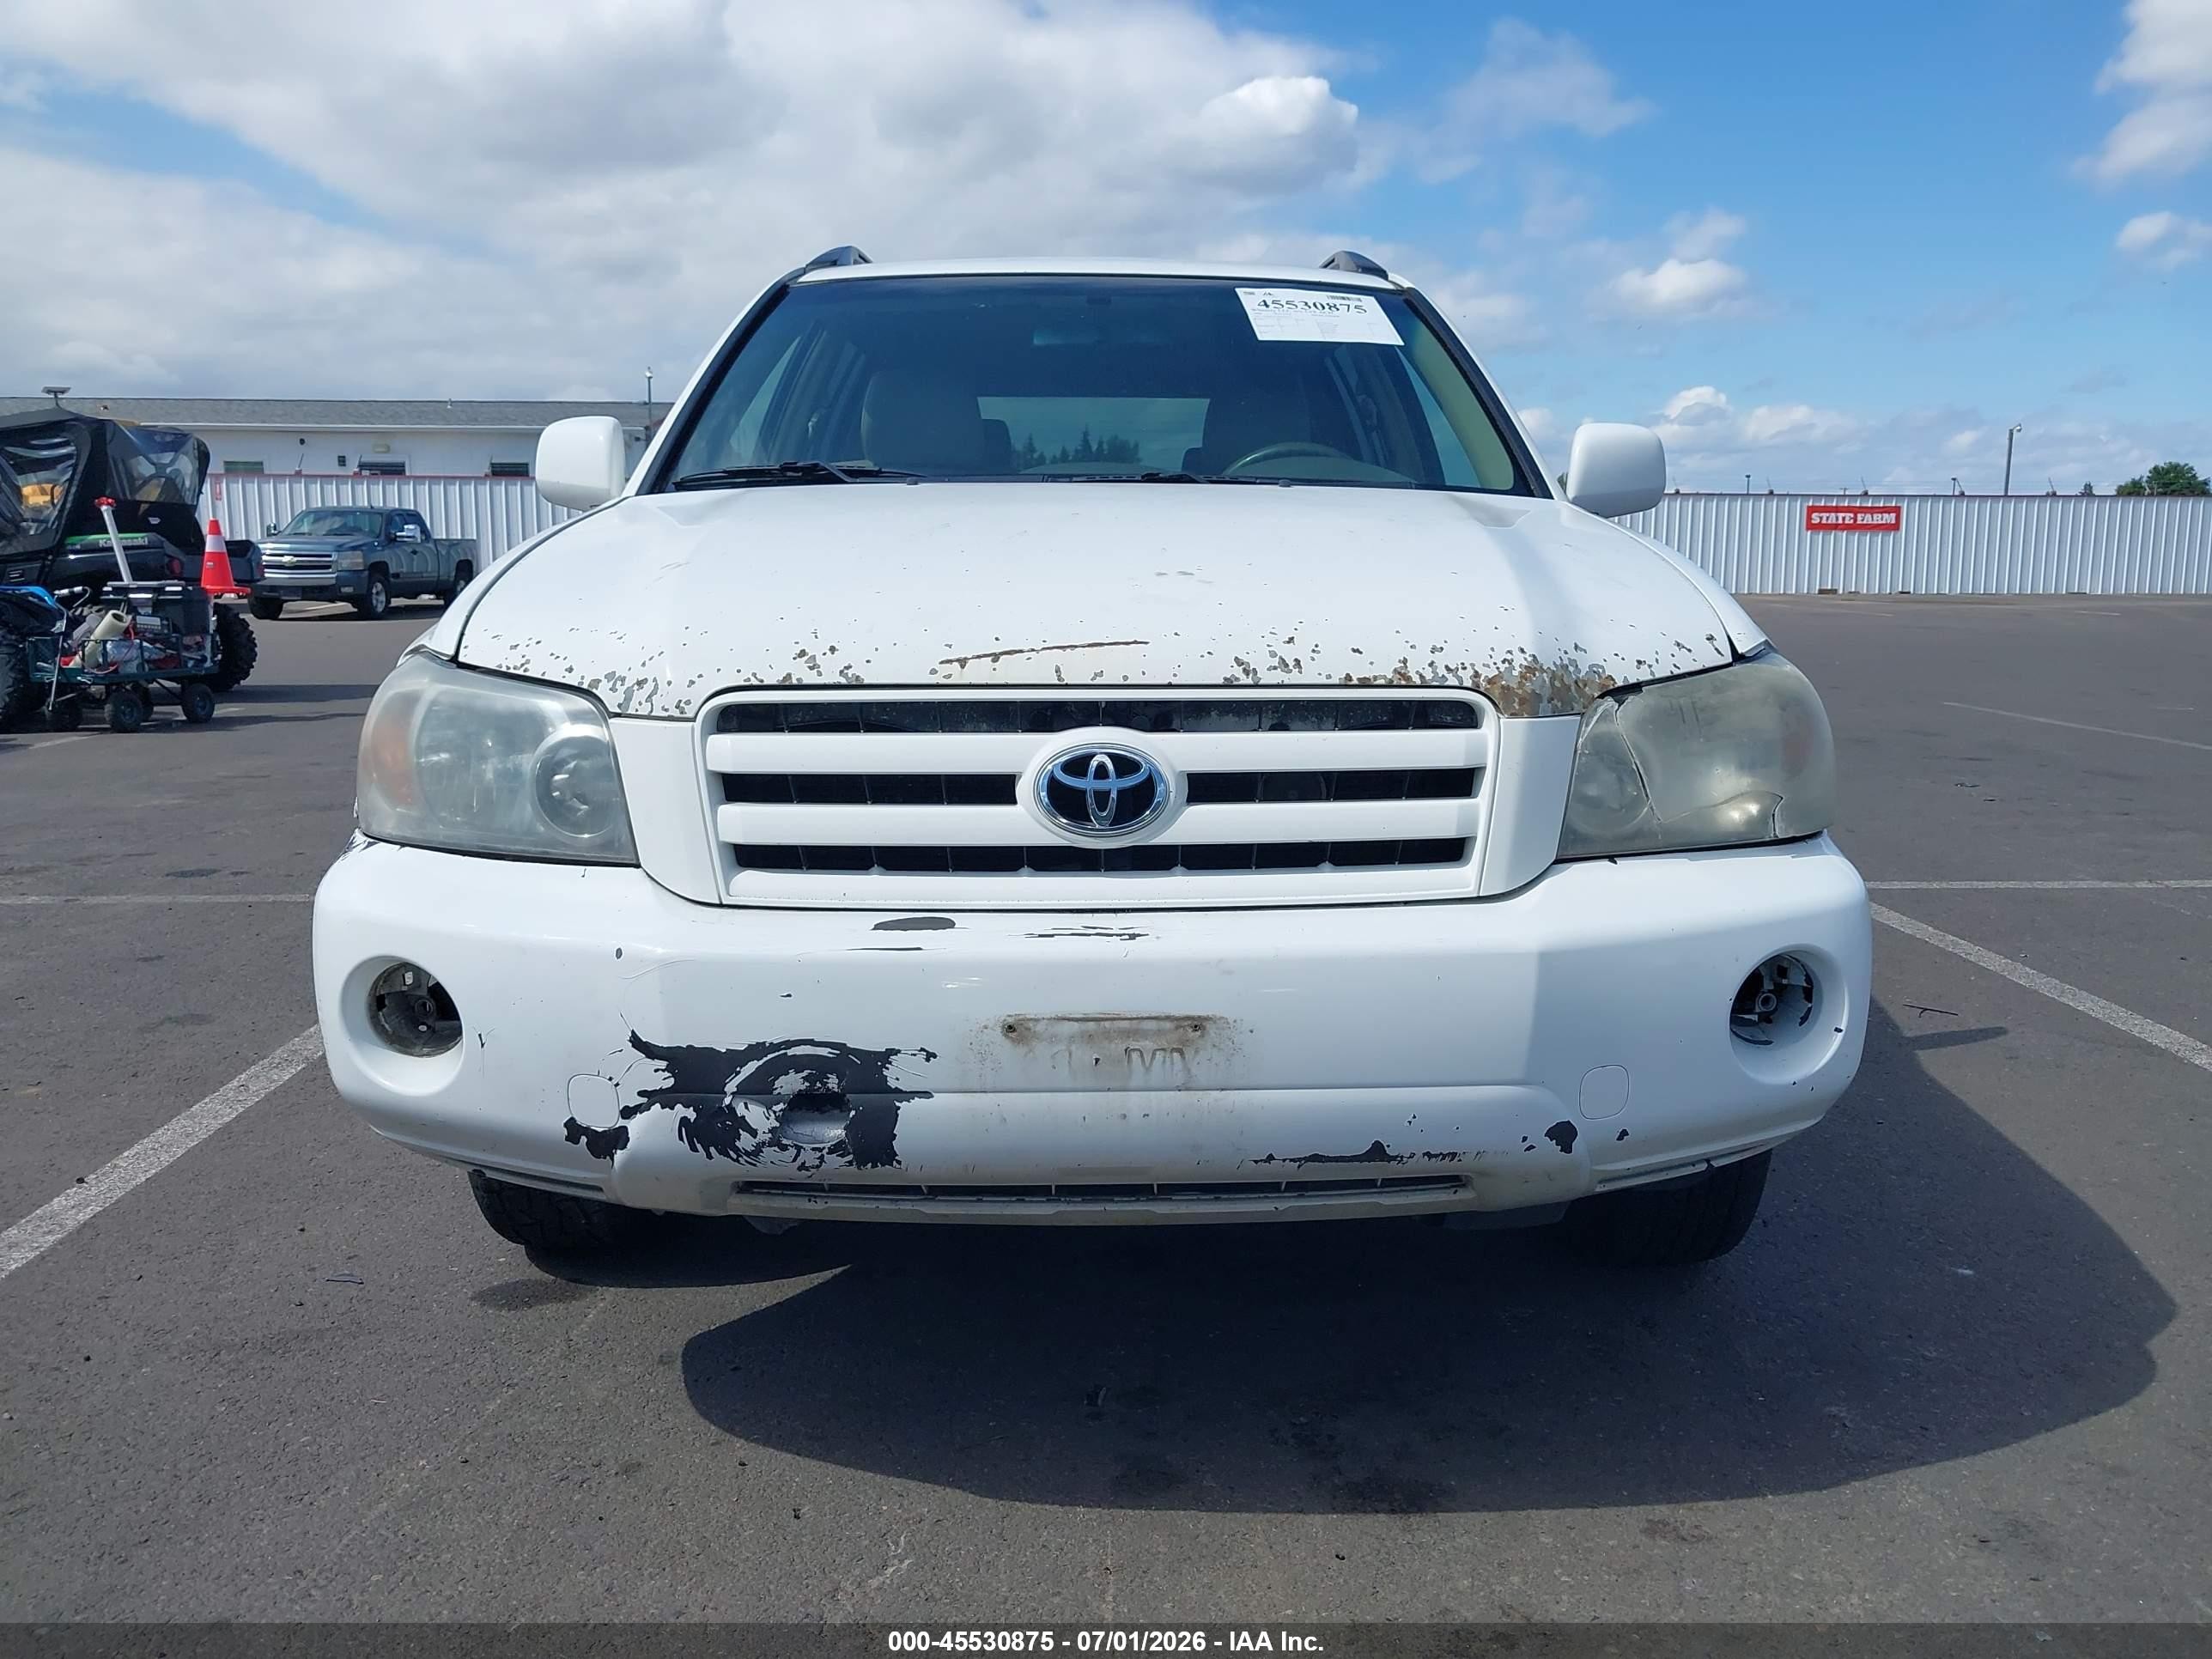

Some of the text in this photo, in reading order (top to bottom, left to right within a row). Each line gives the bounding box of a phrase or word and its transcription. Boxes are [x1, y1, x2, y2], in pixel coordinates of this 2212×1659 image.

[1257, 299, 1367, 313] 45530875
[1811, 512, 1896, 524] STATE FARM
[99, 537, 148, 547] Kaasaki
